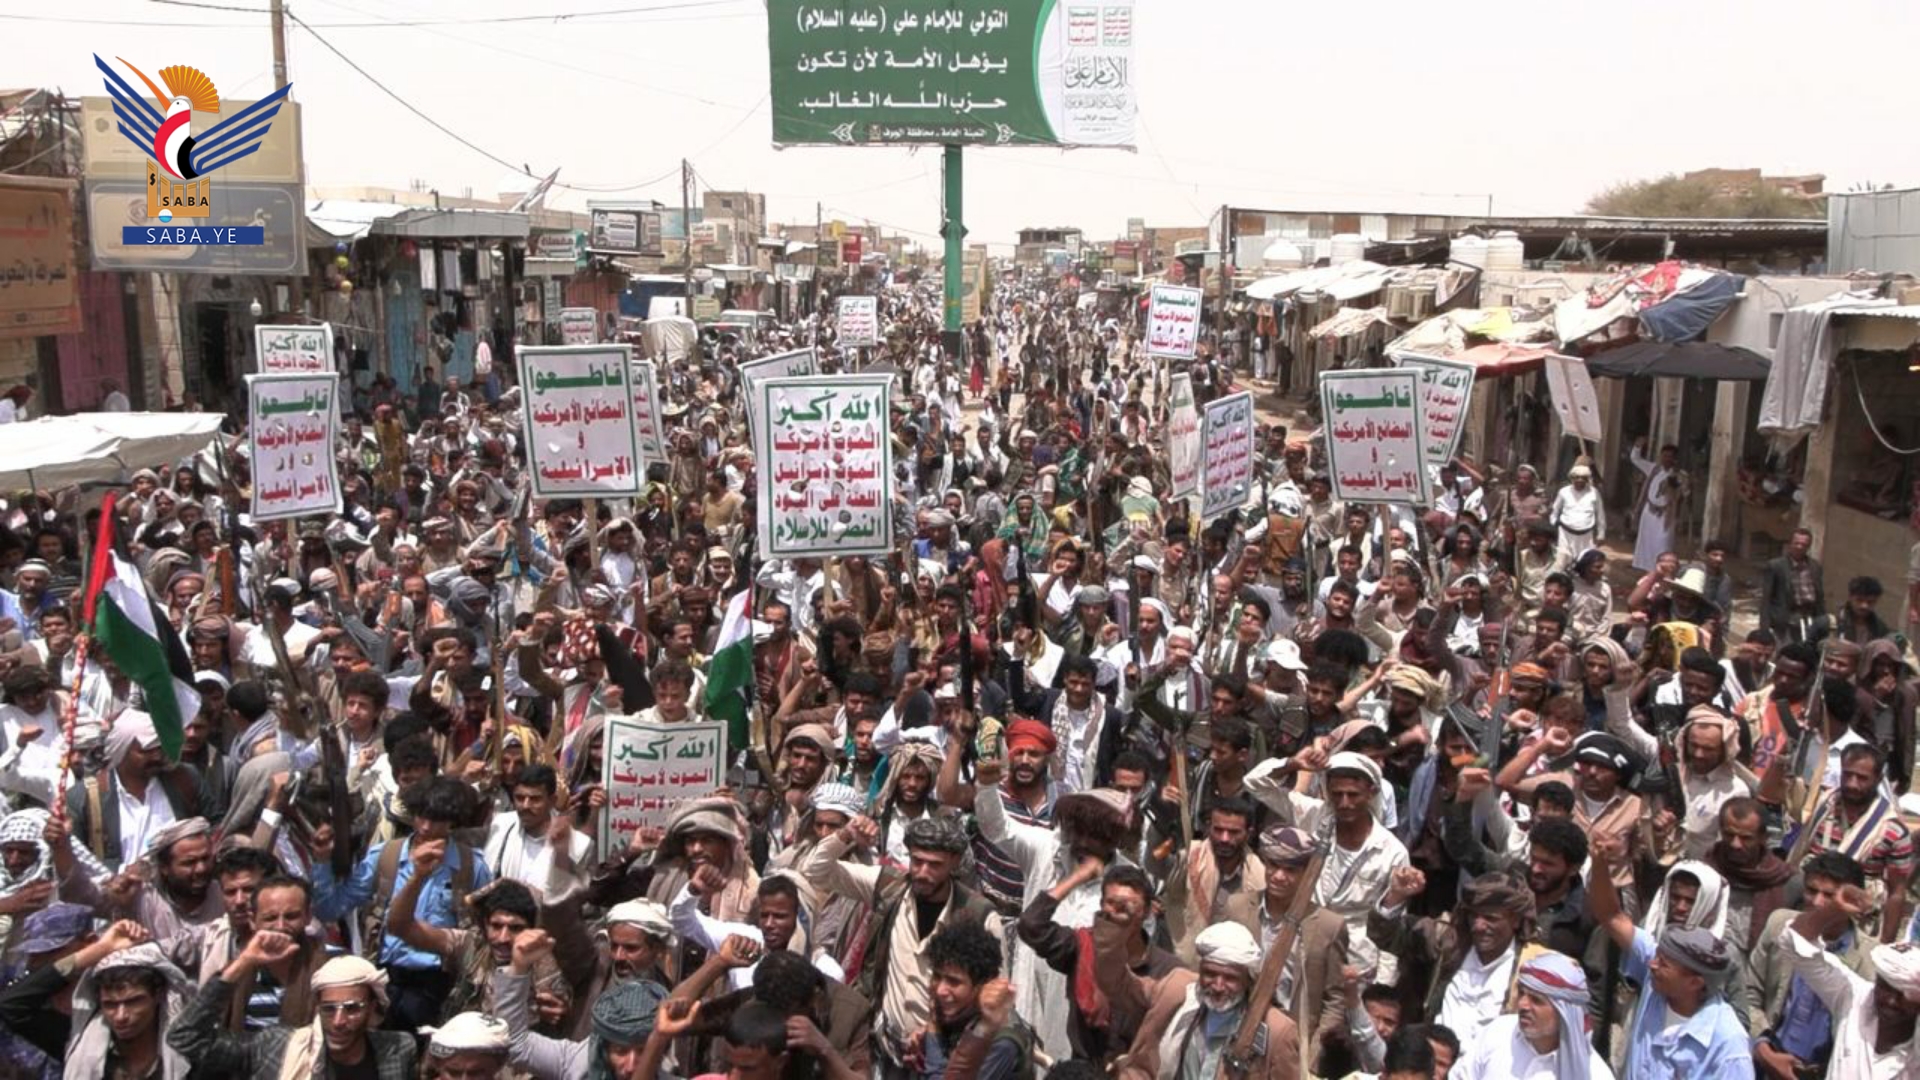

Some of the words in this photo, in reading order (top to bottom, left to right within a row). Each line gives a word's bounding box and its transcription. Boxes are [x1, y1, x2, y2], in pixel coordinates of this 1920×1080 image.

[893, 9, 919, 37] علي
[924, 8, 963, 34] للإمام
[969, 8, 1008, 37] التولي
[797, 51, 847, 73] تكون
[853, 46, 878, 73] لأن
[884, 46, 942, 69] الأمة
[948, 51, 1008, 74] يؤهل
[950, 91, 1007, 115] حزب
[883, 127, 905, 139] الجوف
[906, 126, 935, 138] محافظة
[942, 126, 961, 138] العامة
[266, 333, 300, 354] أكبر
[301, 334, 323, 351] الله
[528, 362, 624, 396] قاطعوا
[1442, 371, 1467, 388] الله
[255, 387, 328, 420] قاطعوا
[773, 389, 838, 430] أكبر
[841, 392, 880, 421] الله
[1329, 384, 1411, 414] قاطعوا
[533, 398, 582, 427] الأمريكية
[584, 399, 625, 426] البضائع
[257, 421, 295, 449] الأمريكية
[296, 423, 326, 447] البضائع
[834, 431, 880, 453] الموت
[1334, 417, 1376, 443] الأمريكية
[1377, 421, 1412, 442] البضائع
[540, 456, 631, 483] الإسرائيلية
[834, 461, 880, 485] الموت
[1340, 471, 1418, 491] الإسرائيلية
[260, 473, 330, 505] الإسرائيلية
[775, 489, 814, 512] اليهود
[846, 488, 881, 508] اللعنة
[775, 515, 829, 546] للإسلام
[836, 514, 881, 544] النصر
[614, 734, 674, 766] أكبر
[676, 735, 714, 759] الله
[613, 765, 666, 788] لأمريكا
[669, 767, 713, 788] الموت
